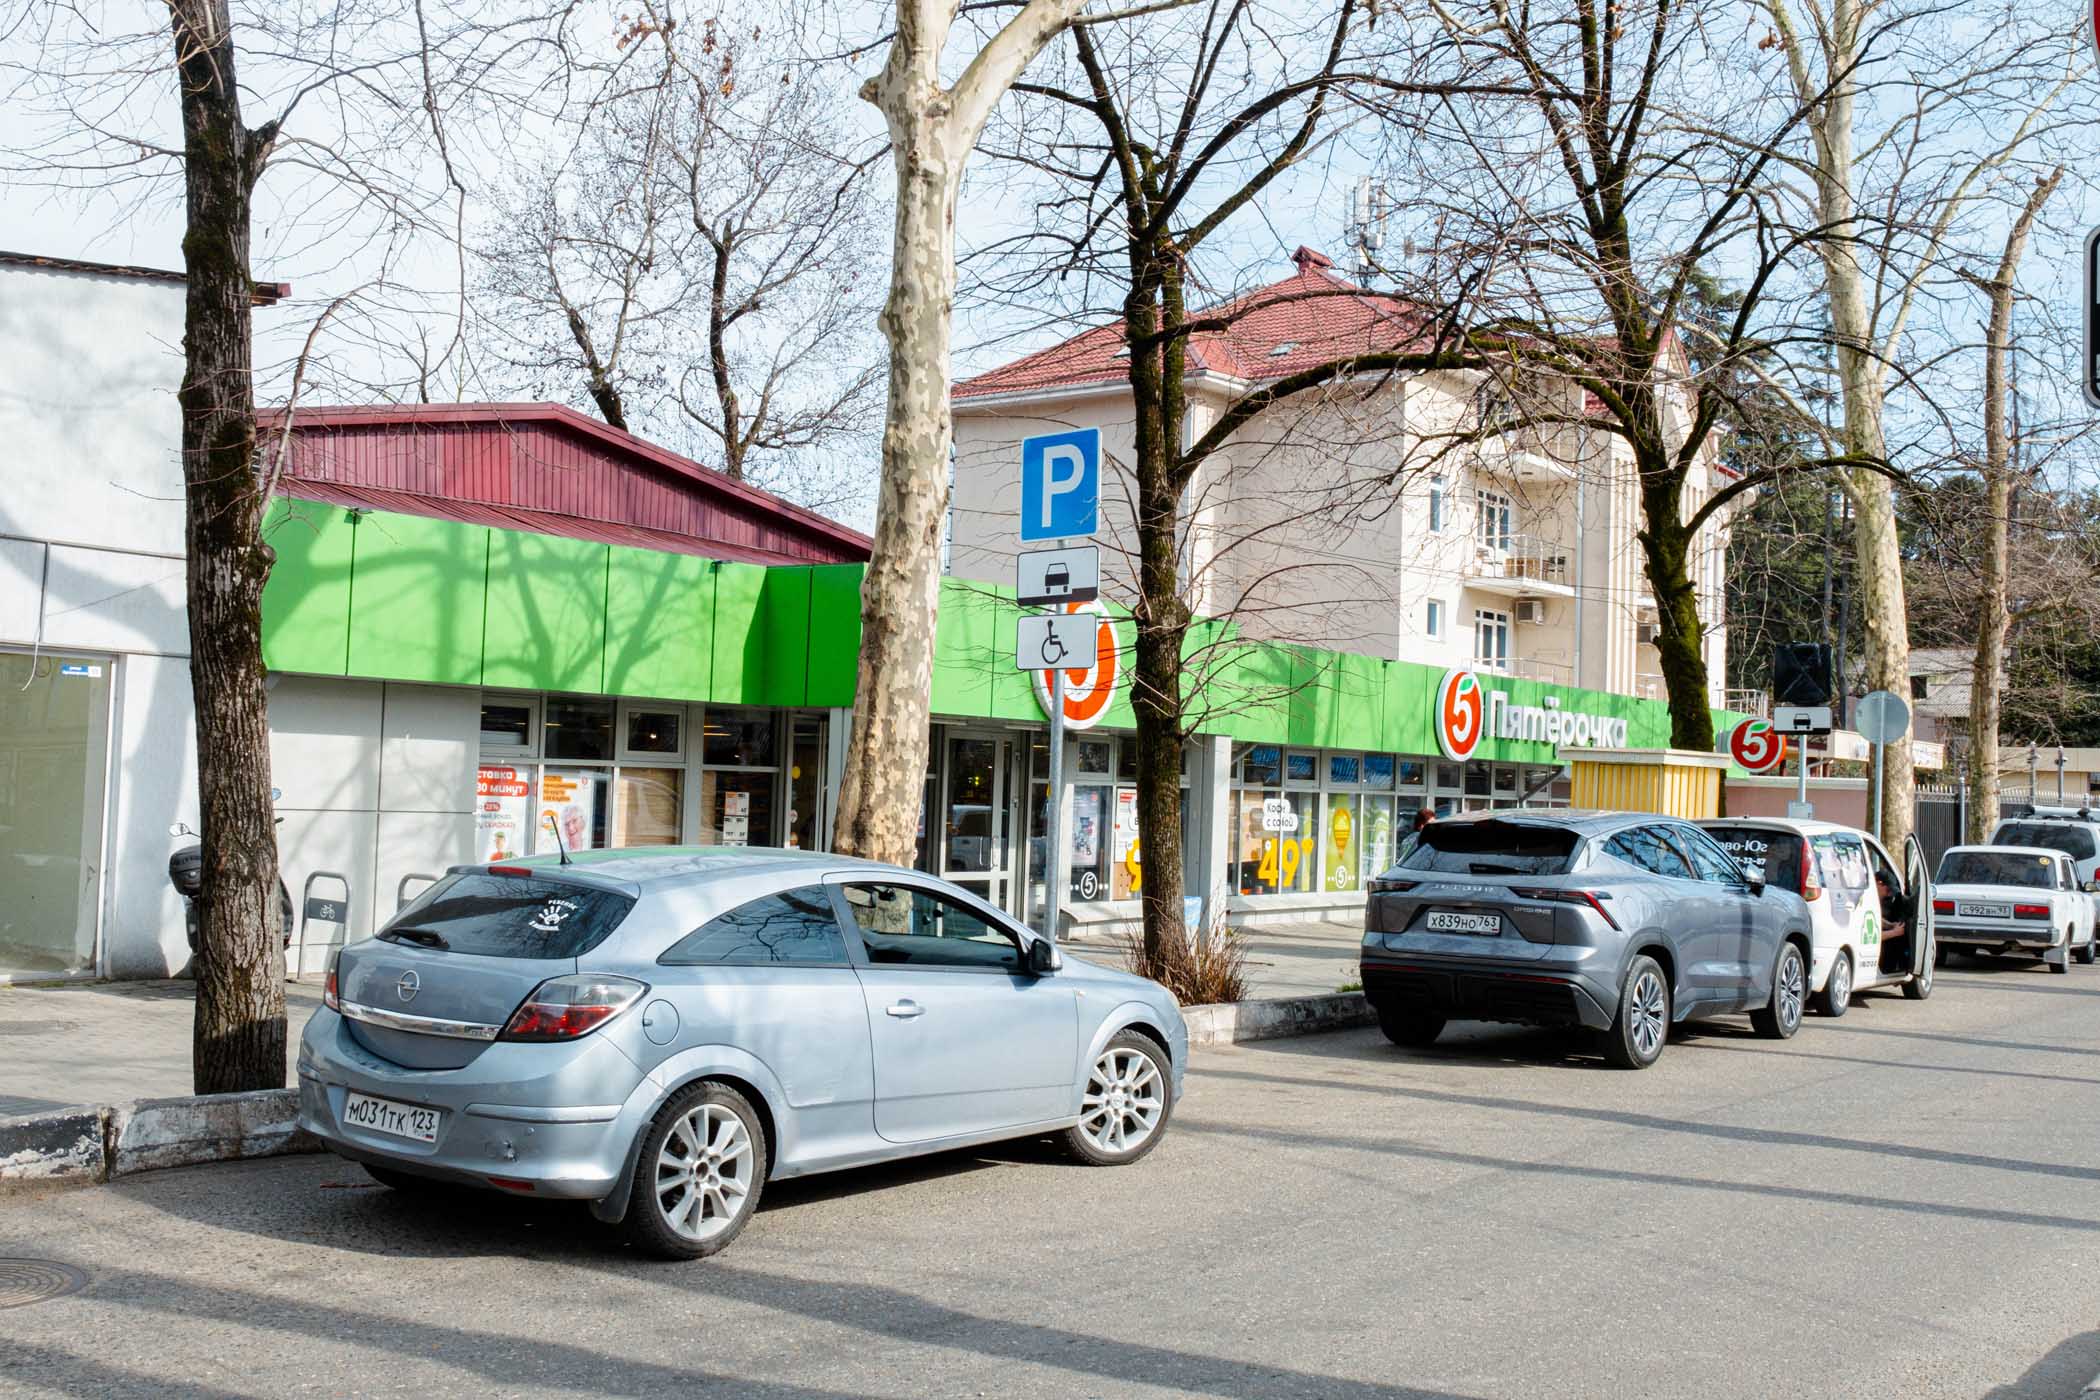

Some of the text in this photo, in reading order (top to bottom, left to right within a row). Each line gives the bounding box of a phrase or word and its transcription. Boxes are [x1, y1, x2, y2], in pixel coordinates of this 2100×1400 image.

[1042, 443, 1085, 528] P
[1451, 675, 1627, 747] 5 Пятёрочка
[1741, 722, 1769, 762] 5
[490, 785, 524, 796] минут
[1258, 838, 1299, 888] 49
[1478, 916, 1497, 928] 763
[348, 1100, 435, 1132] М031ТК 123
